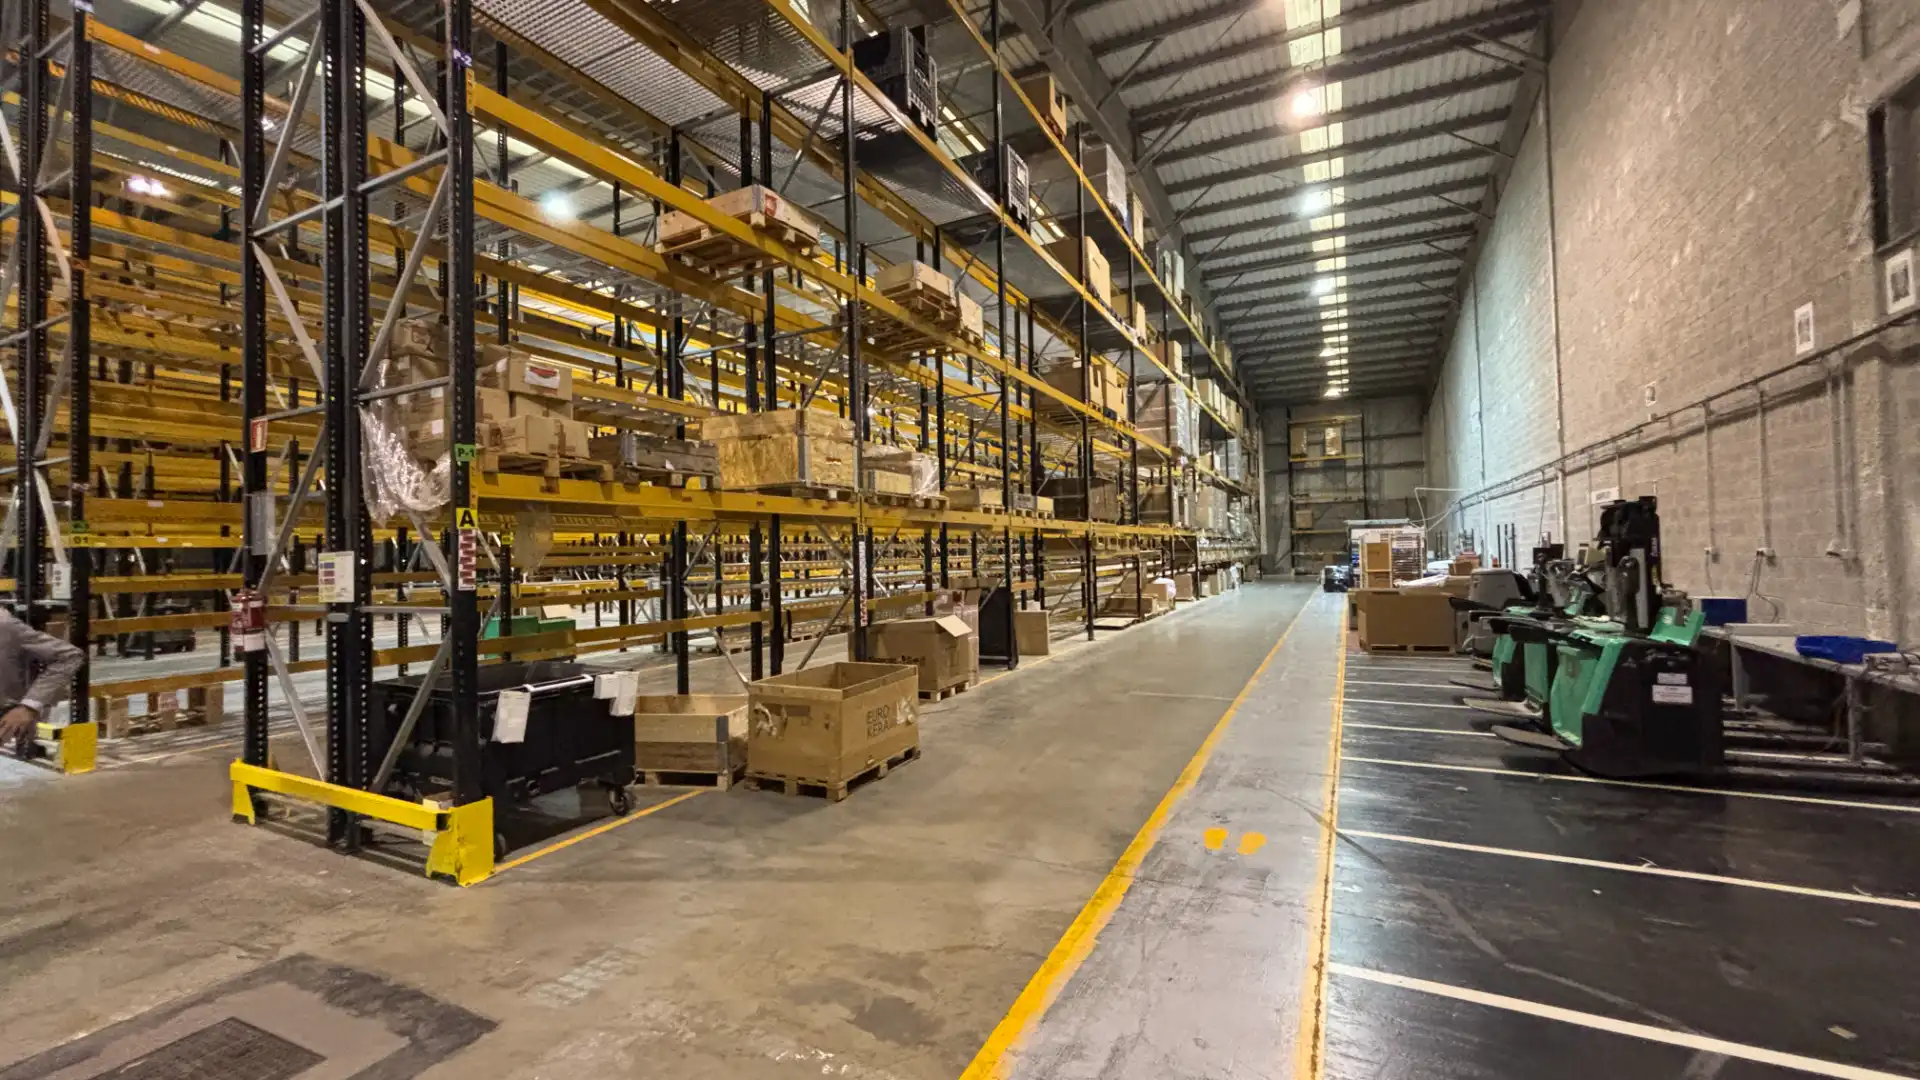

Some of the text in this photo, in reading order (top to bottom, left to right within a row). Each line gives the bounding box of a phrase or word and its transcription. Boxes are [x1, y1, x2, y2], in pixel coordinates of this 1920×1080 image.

[453, 49, 472, 67] P-2
[458, 448, 475, 458] P-1
[459, 510, 475, 528] A
[867, 704, 890, 725] EURO
